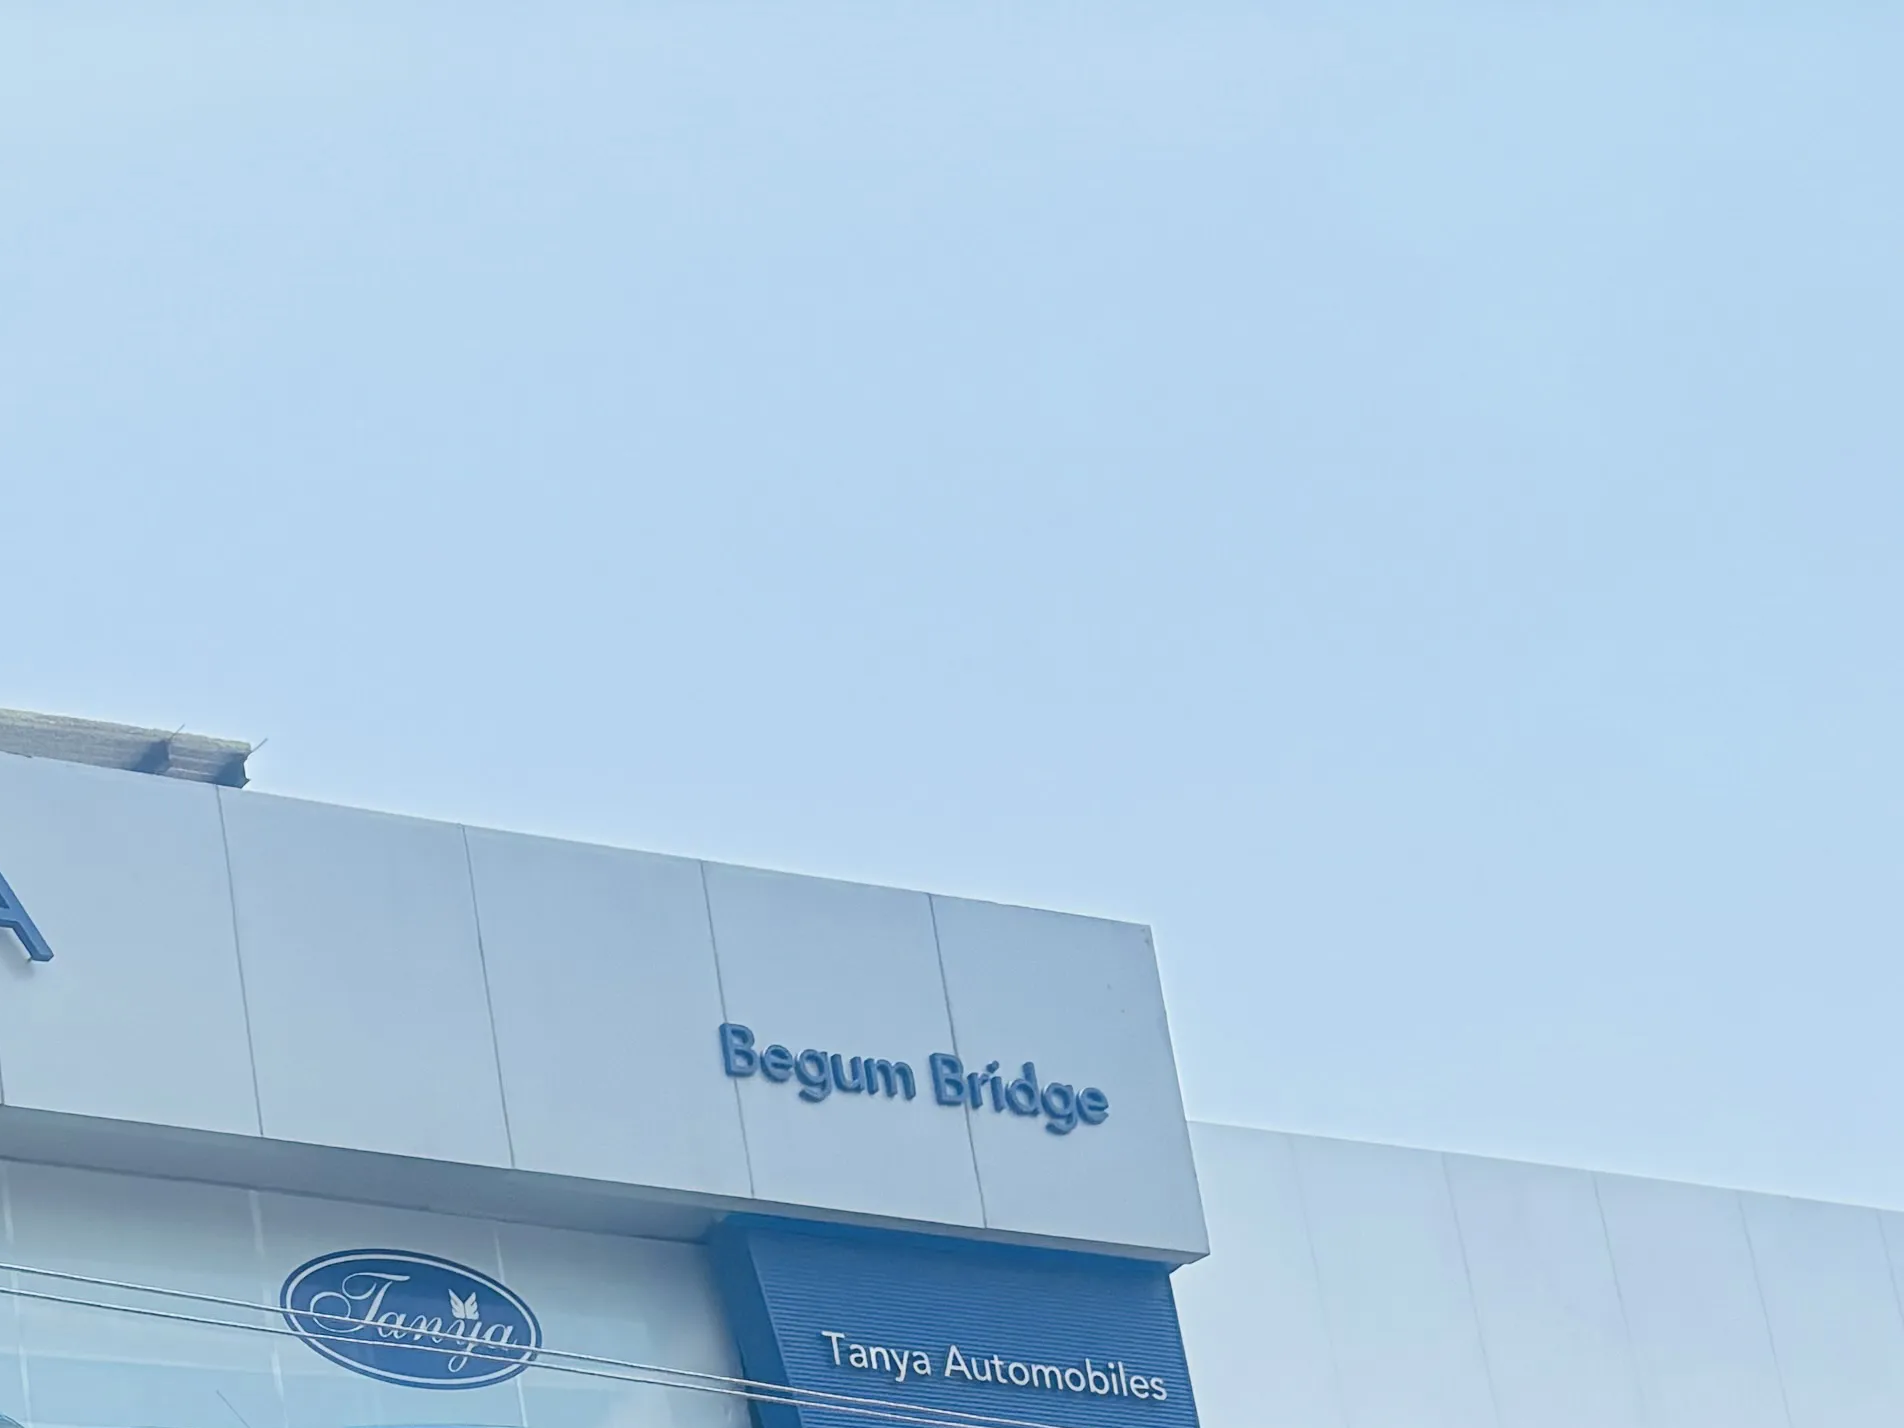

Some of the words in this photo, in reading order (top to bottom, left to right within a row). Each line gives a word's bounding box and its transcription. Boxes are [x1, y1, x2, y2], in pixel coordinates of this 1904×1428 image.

[718, 1022, 916, 1104] Begum
[929, 1050, 1110, 1135] Bridge
[309, 1270, 519, 1371] Tanya
[821, 1330, 932, 1383] Tanya
[943, 1345, 1169, 1404] Automobiles
